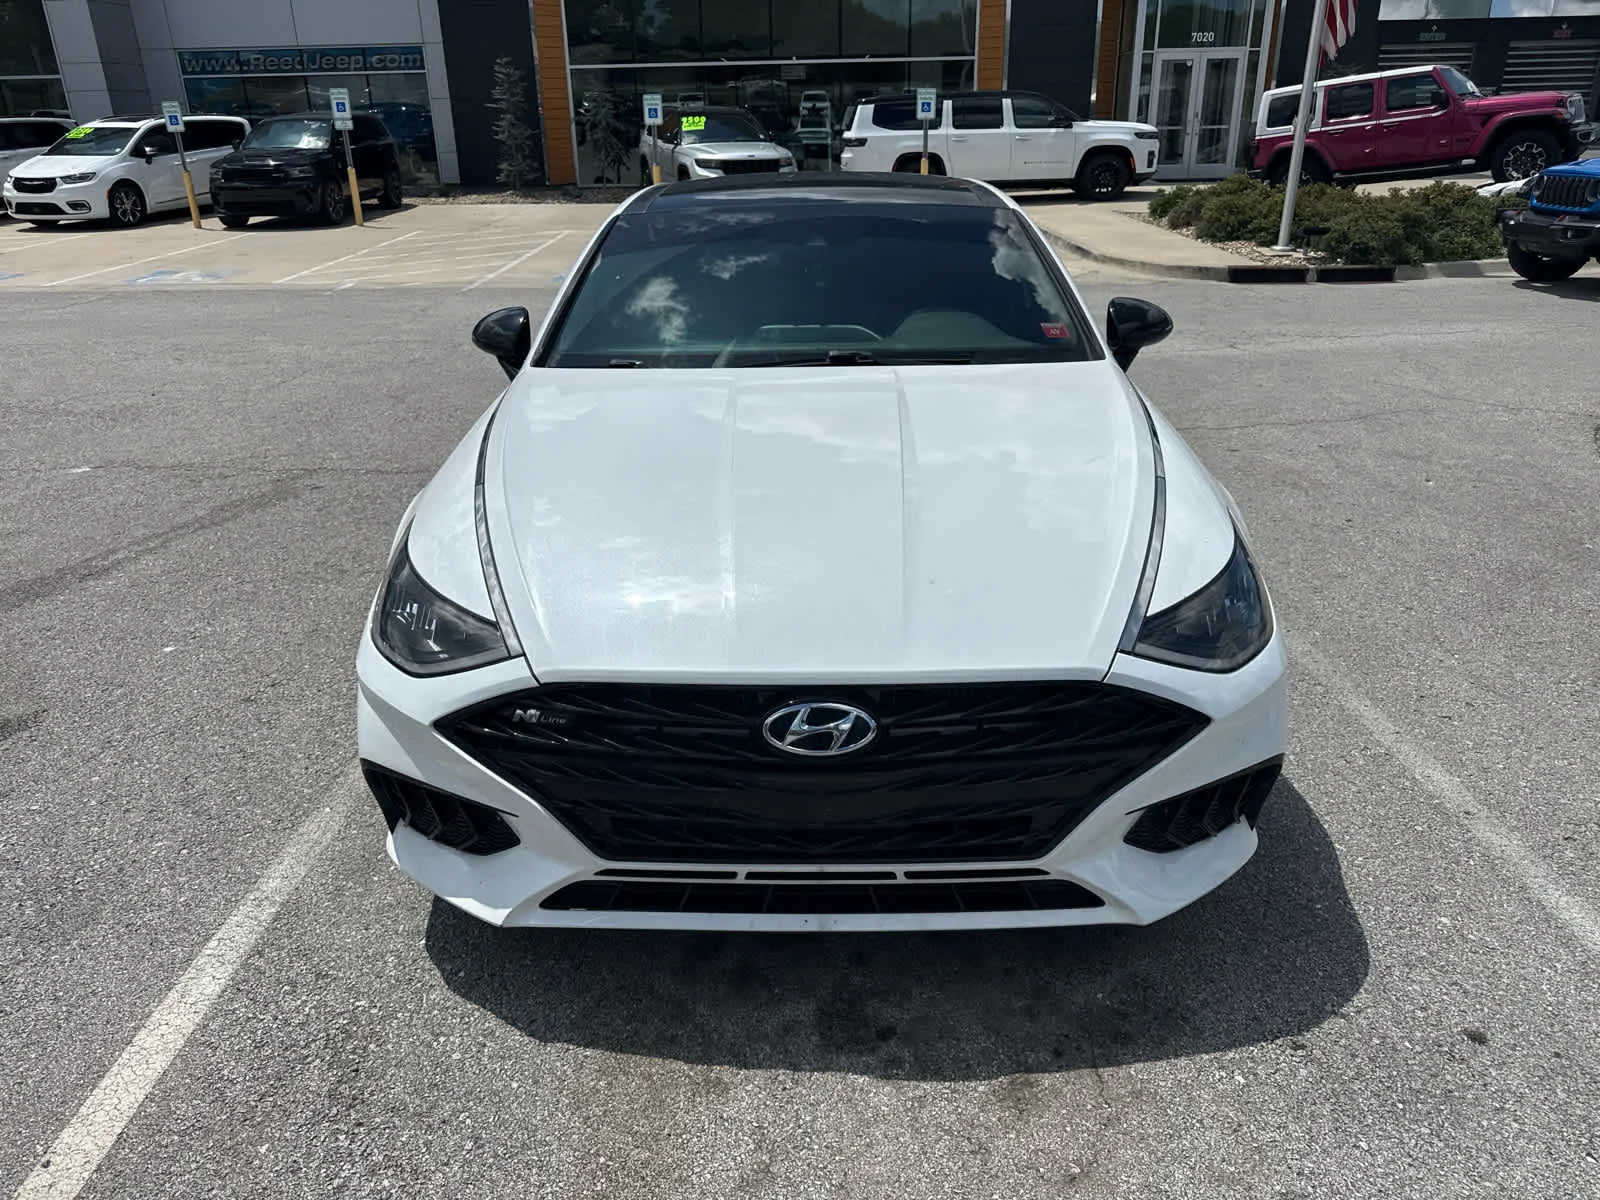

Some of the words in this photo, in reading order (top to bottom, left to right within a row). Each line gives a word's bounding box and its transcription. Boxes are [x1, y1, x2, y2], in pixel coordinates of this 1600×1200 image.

[1191, 31, 1215, 42] 7020
[1419, 32, 1446, 41] ENTER
[183, 52, 421, 73] www.ReedJeep.com
